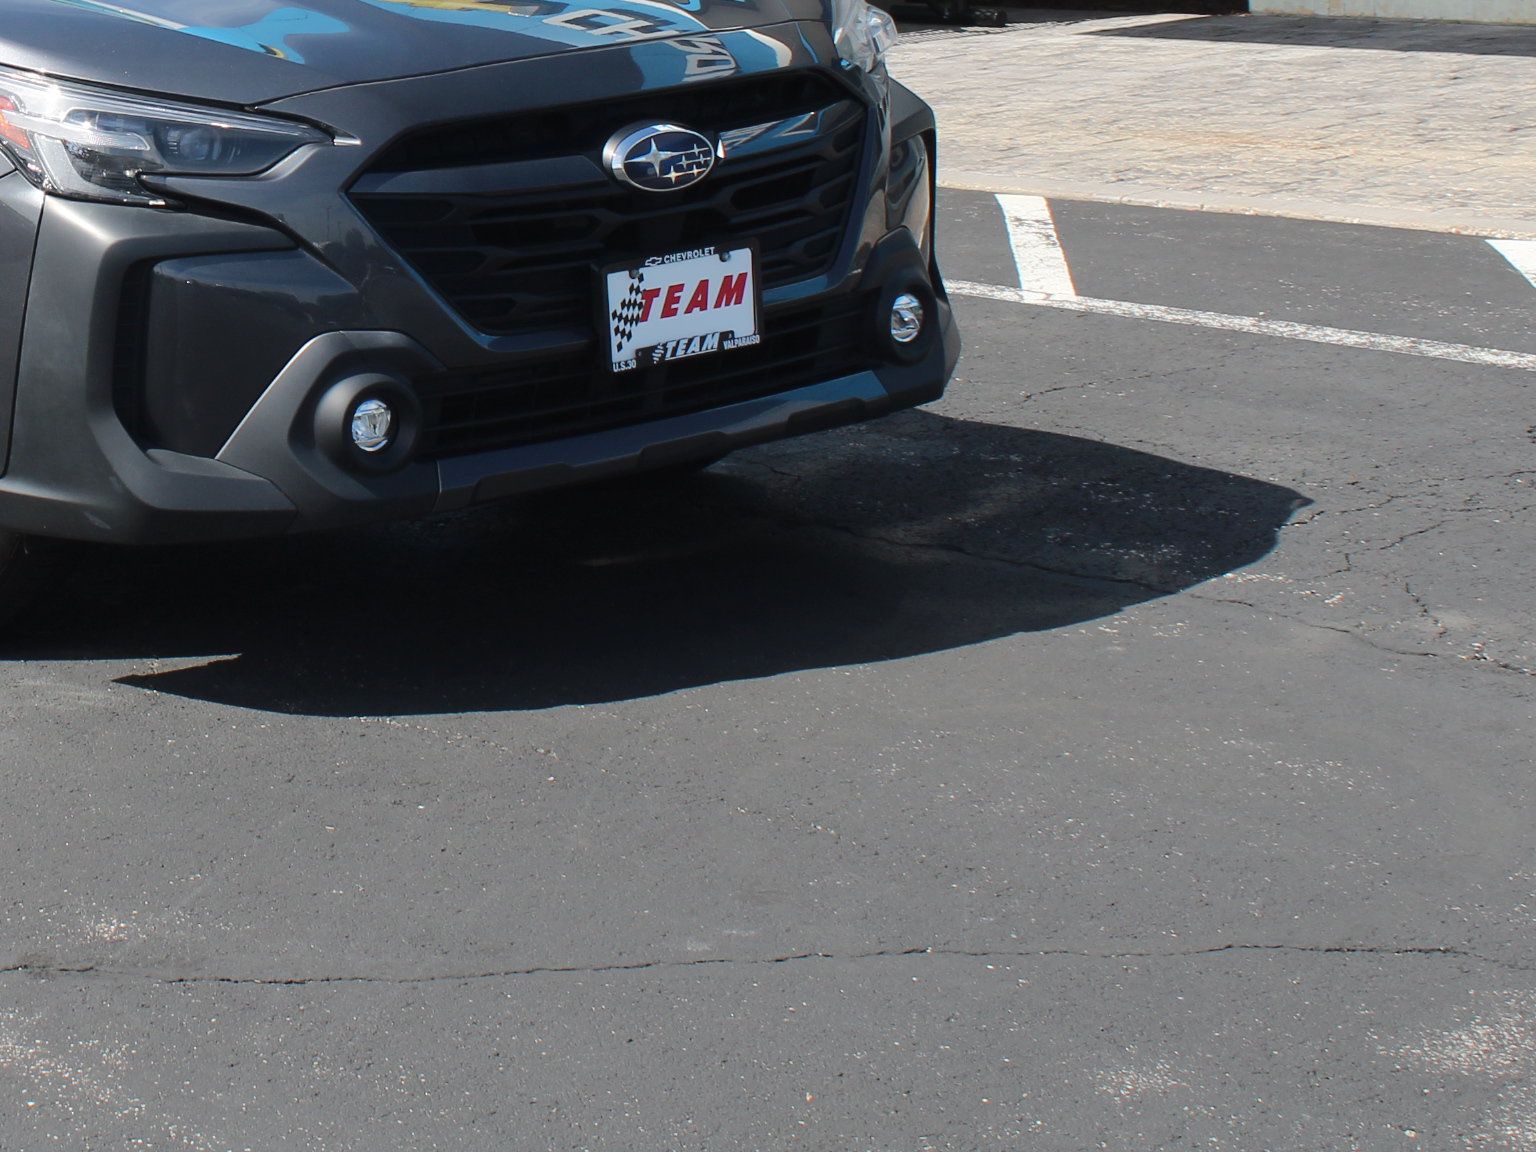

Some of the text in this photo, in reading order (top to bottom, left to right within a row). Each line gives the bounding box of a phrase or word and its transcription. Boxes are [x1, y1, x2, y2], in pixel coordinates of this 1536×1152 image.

[664, 247, 715, 264] CHEVROLET
[640, 272, 747, 322] TEAM
[665, 332, 720, 359] TEAM
[723, 335, 760, 350] VALPARAISO
